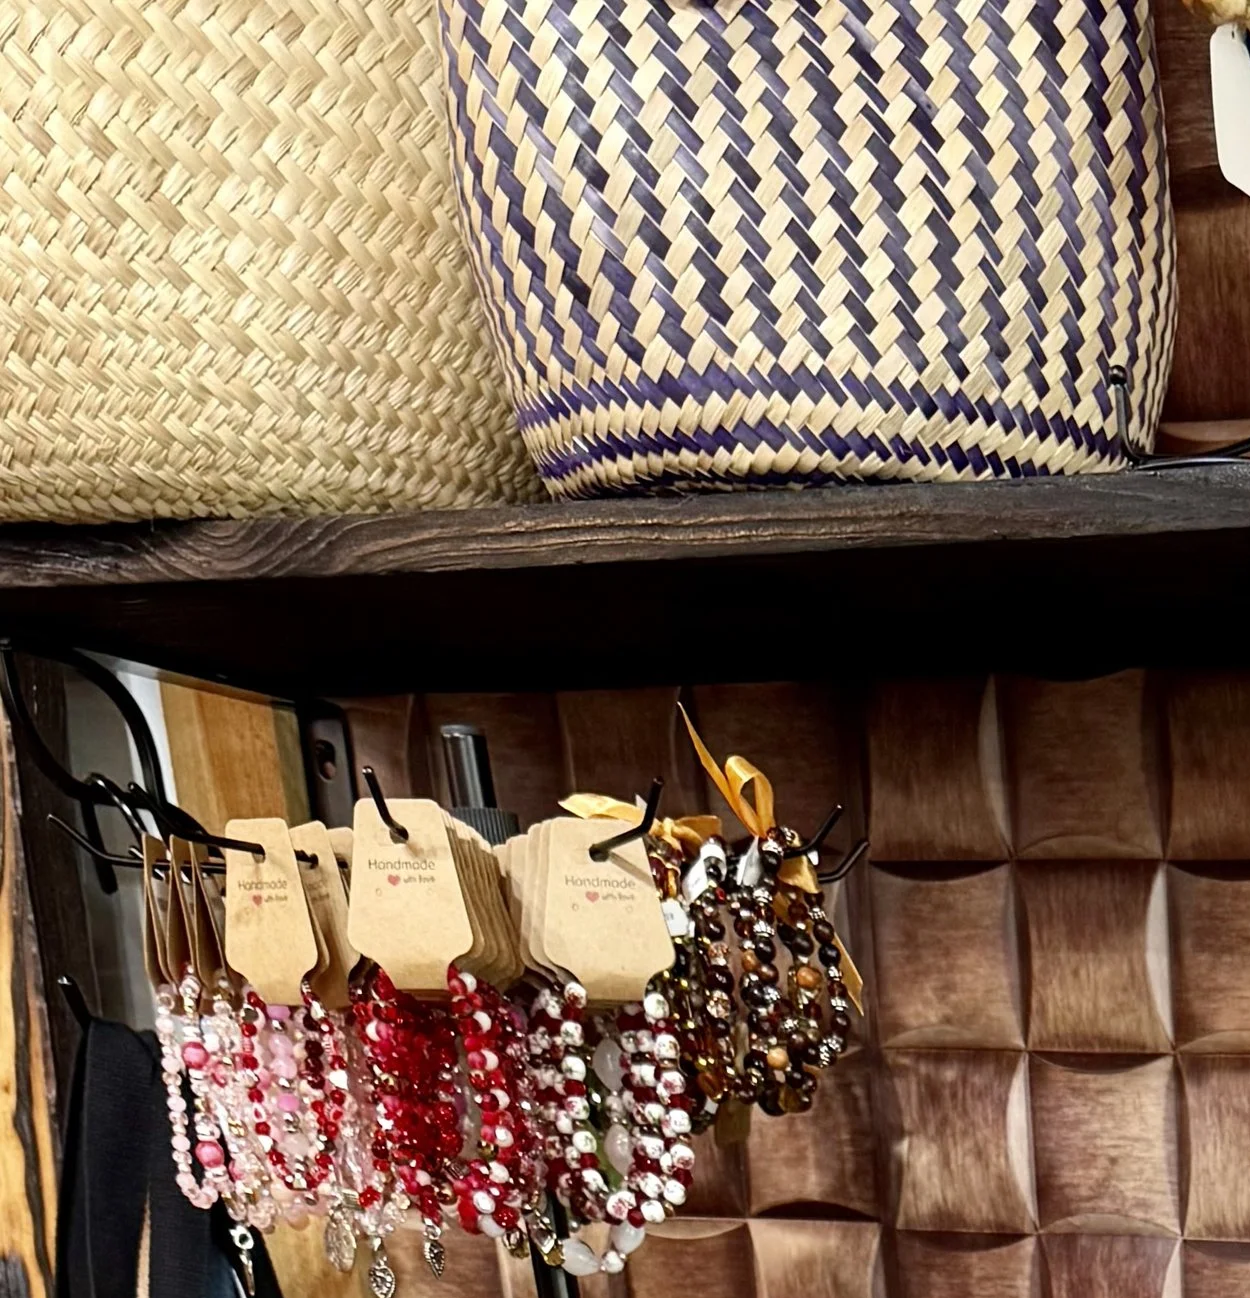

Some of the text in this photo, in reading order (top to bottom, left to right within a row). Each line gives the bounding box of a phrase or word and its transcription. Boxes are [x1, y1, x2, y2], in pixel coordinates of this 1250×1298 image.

[368, 858, 436, 870] Handmade
[237, 878, 288, 891] Handmade
[565, 875, 636, 889] Handmade
